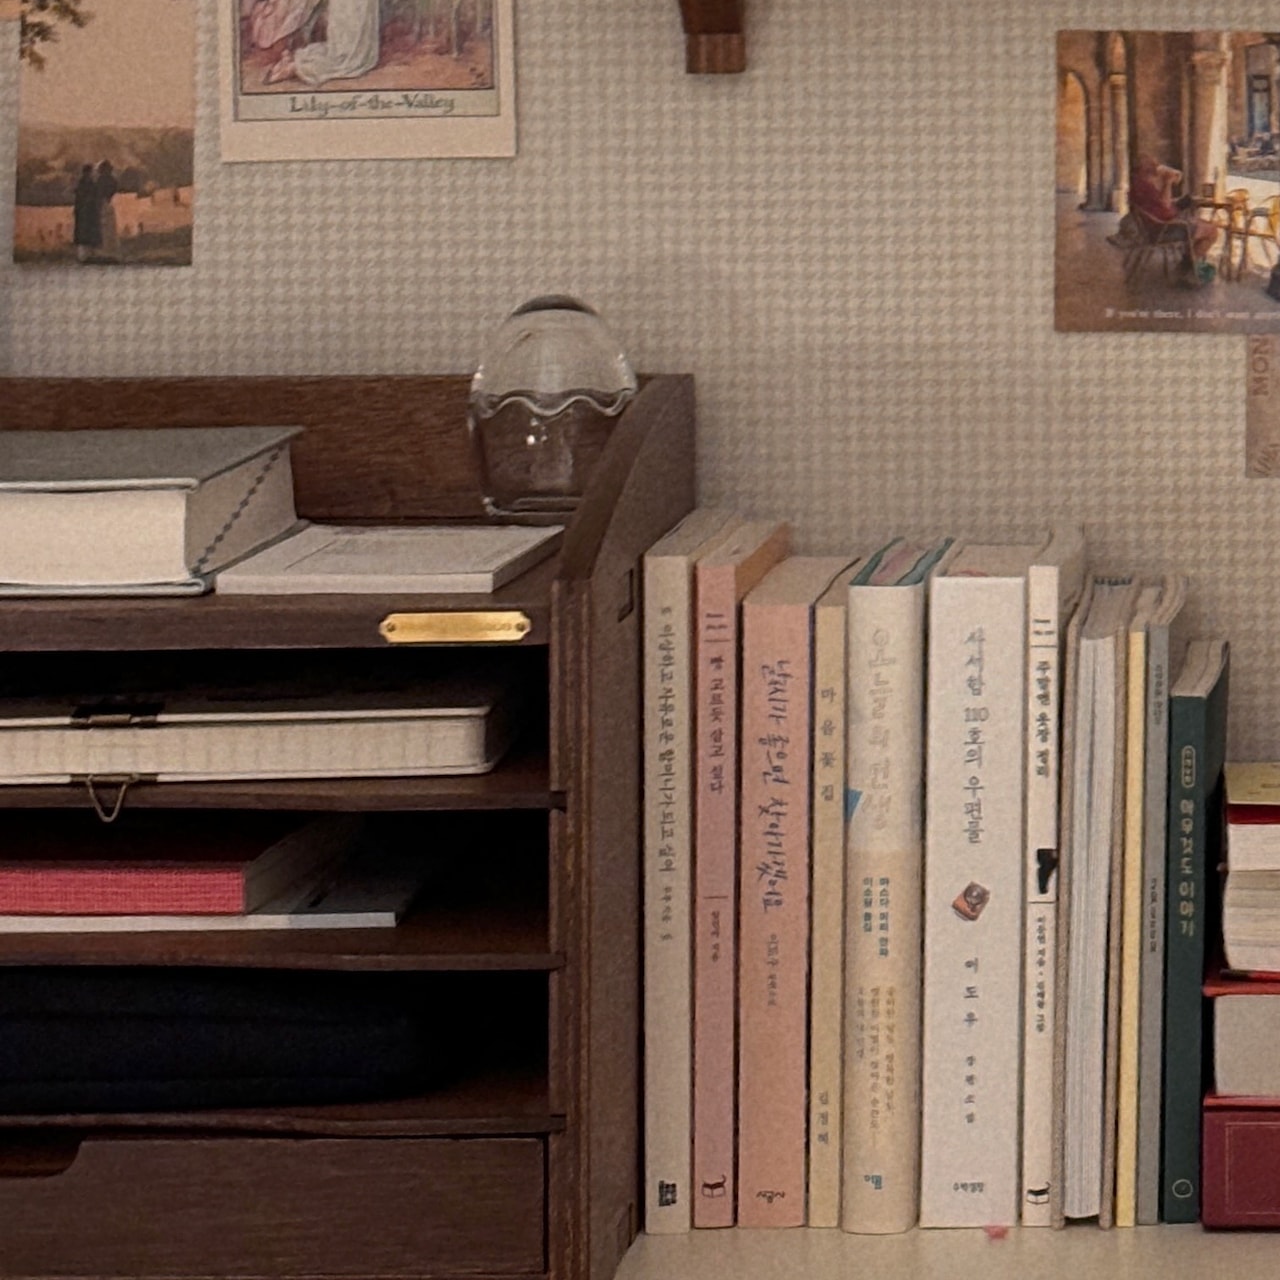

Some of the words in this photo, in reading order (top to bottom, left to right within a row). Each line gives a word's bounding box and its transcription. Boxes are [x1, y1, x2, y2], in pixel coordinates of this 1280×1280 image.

[290, 95, 456, 115] Lily-of-the-Valley
[1252, 337, 1269, 396] MON
[657, 624, 676, 682] 이상하고
[964, 626, 985, 696] 사서함
[657, 687, 676, 744] 자유로운
[761, 660, 794, 725] 날씨가
[657, 750, 676, 806] 할머니가
[758, 733, 791, 785] 좋으면
[657, 810, 676, 841] 되고
[963, 776, 985, 844] 우편물
[657, 844, 676, 873] 싶어
[756, 796, 789, 913] 찾아가겠어요
[963, 958, 979, 1028] 이도우
